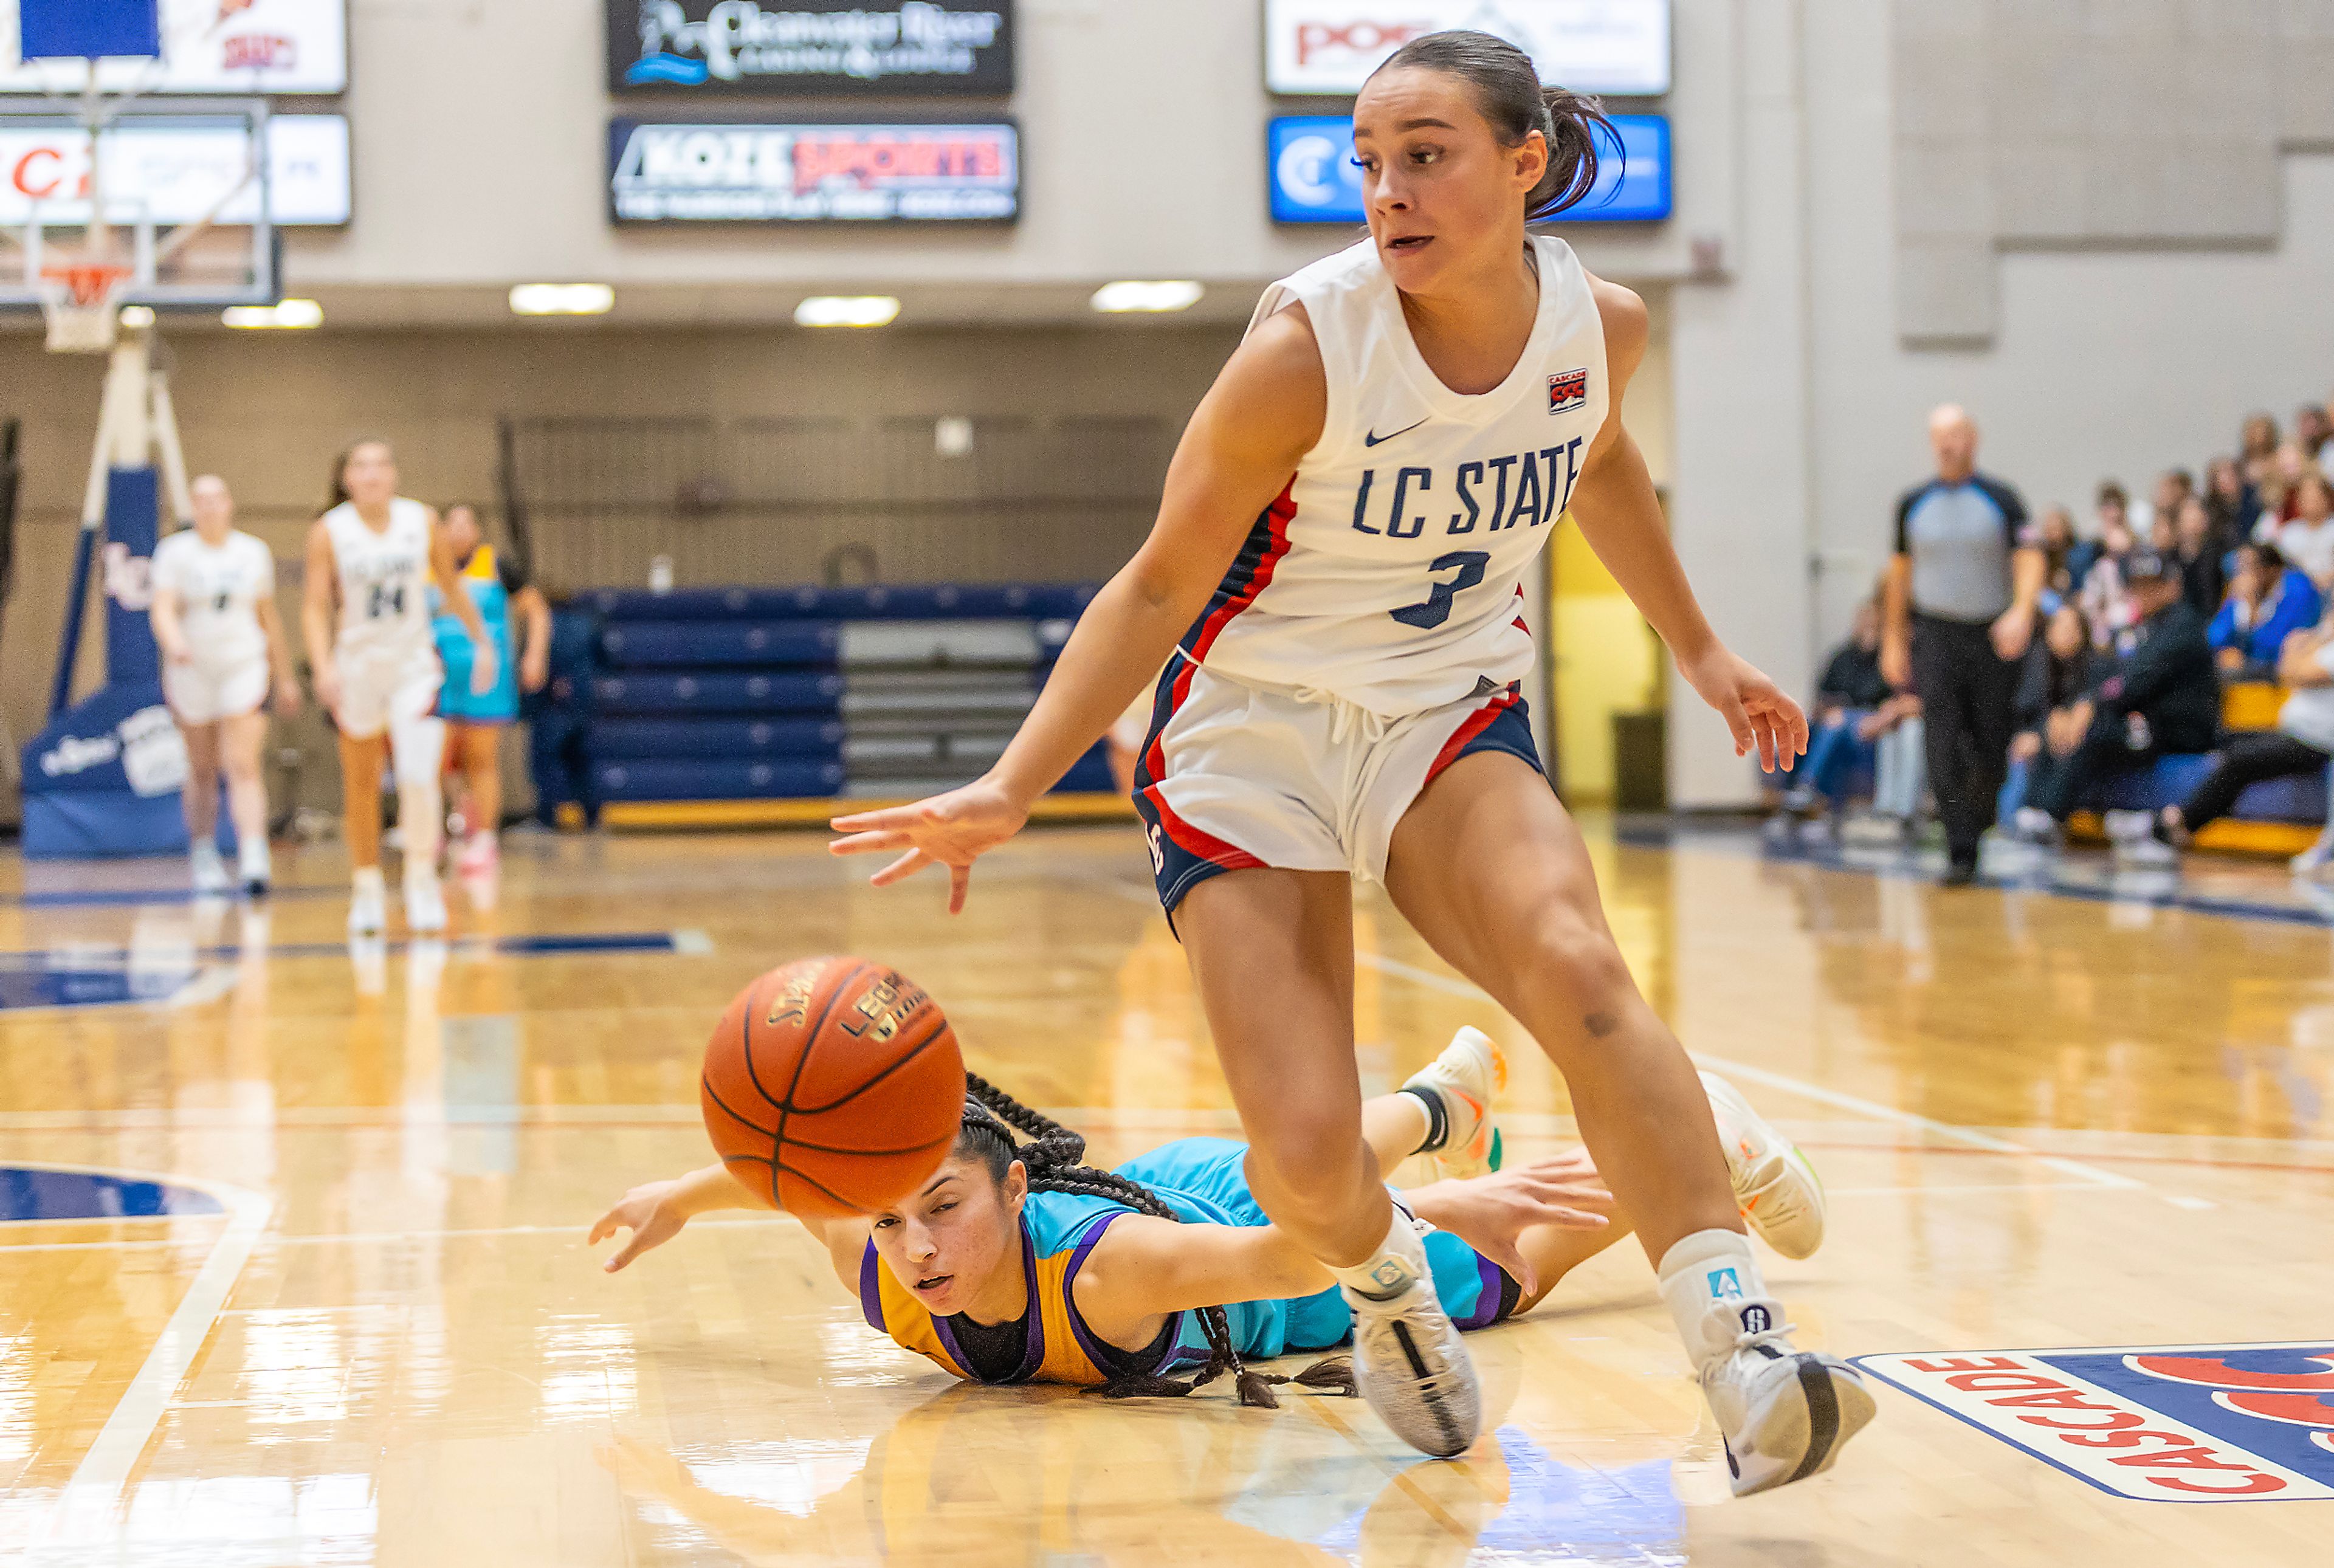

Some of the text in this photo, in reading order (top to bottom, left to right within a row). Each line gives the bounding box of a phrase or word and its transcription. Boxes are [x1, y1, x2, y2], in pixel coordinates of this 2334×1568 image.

[644, 132, 790, 184] KOZE
[1352, 436, 1583, 538] LC STATE
[1388, 551, 1492, 630] 3
[1901, 1356, 2287, 1494] CASCADE
